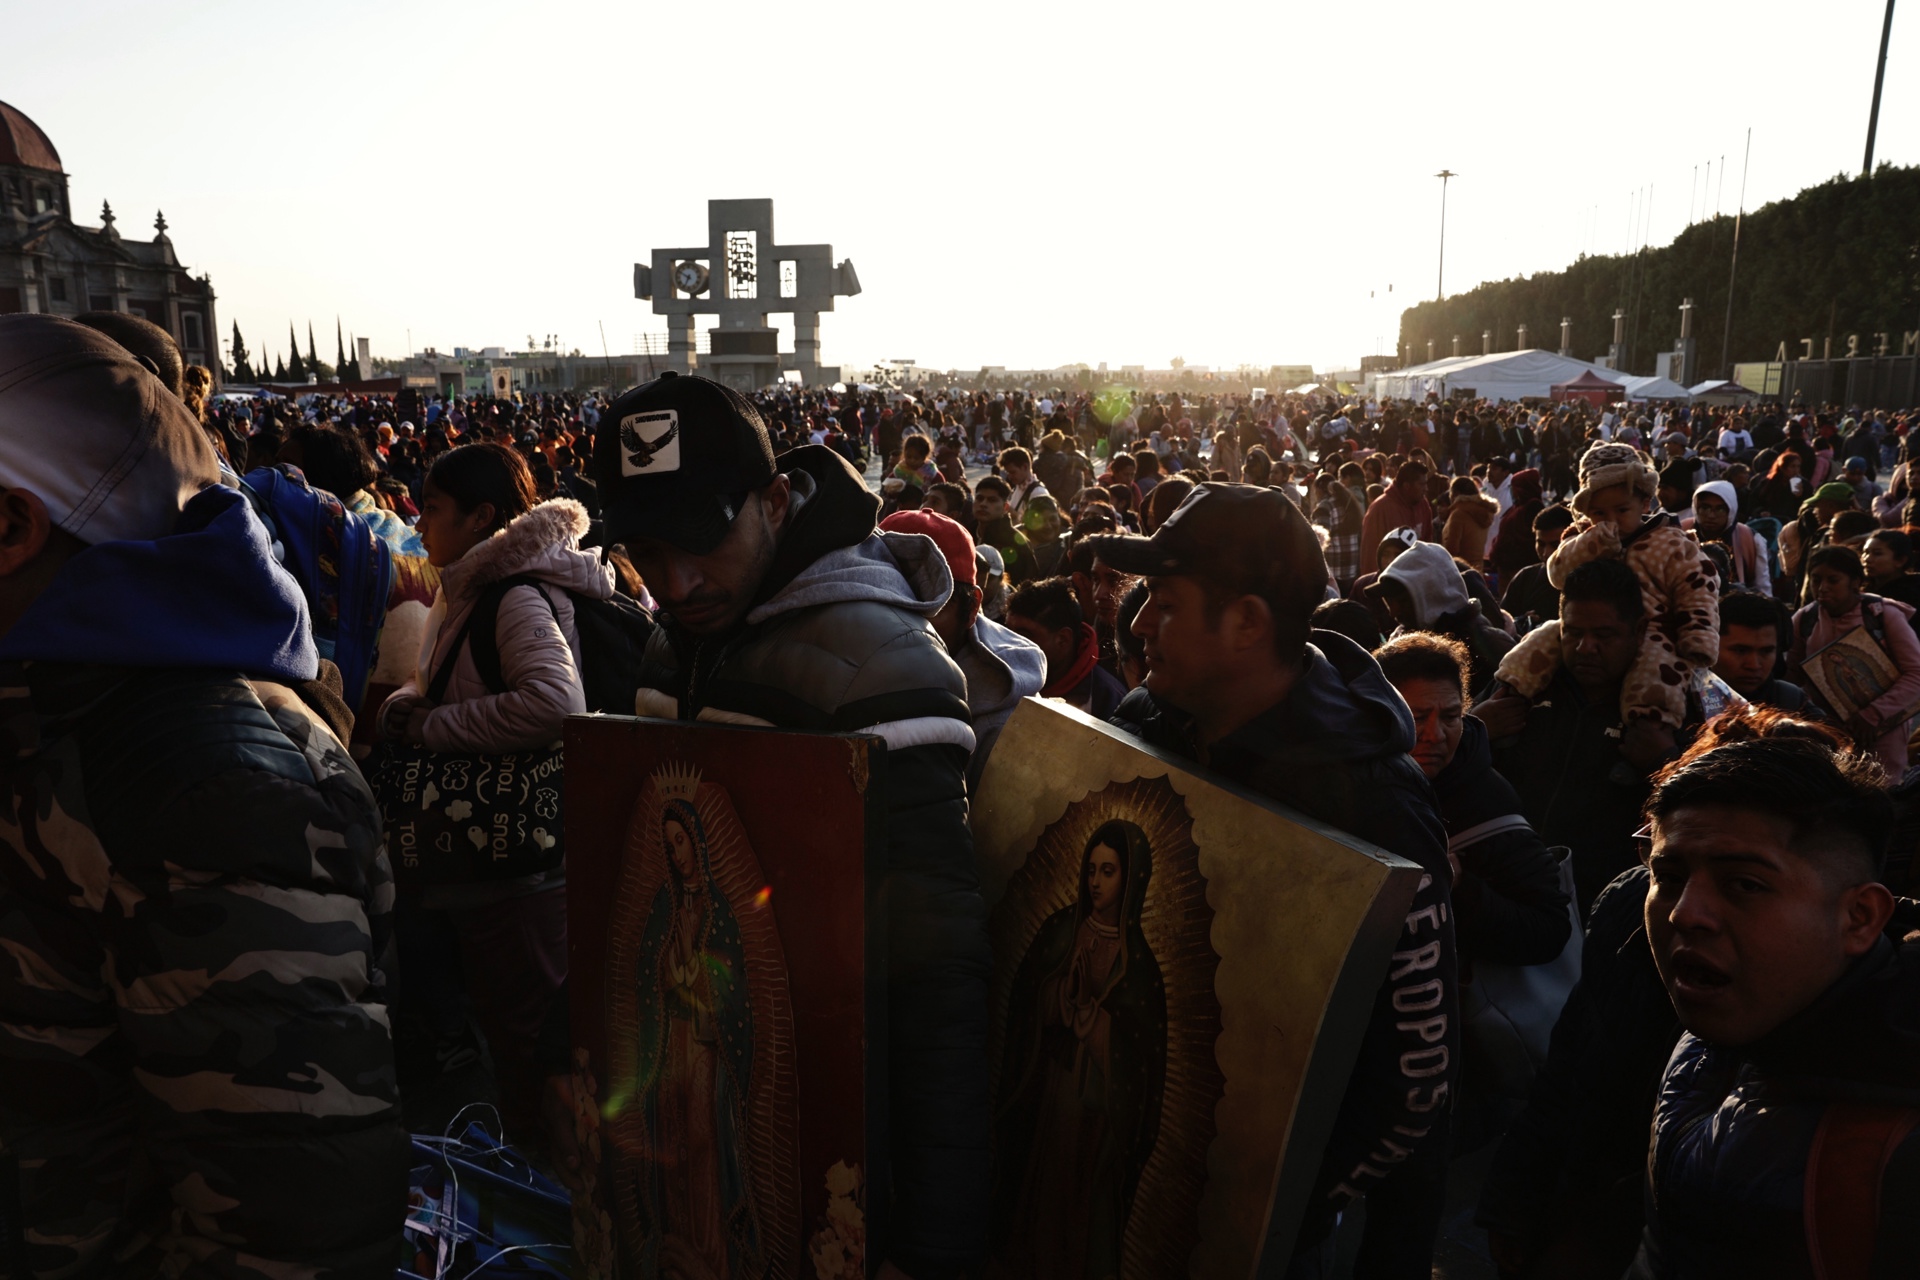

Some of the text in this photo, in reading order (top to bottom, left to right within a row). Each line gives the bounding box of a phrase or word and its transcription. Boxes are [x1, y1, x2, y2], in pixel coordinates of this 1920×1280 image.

[1604, 726, 1621, 739] PUM
[402, 758, 422, 803] TOUS
[496, 754, 517, 796] TOUS
[400, 821, 419, 869] TOUS
[492, 813, 510, 862] TOUS
